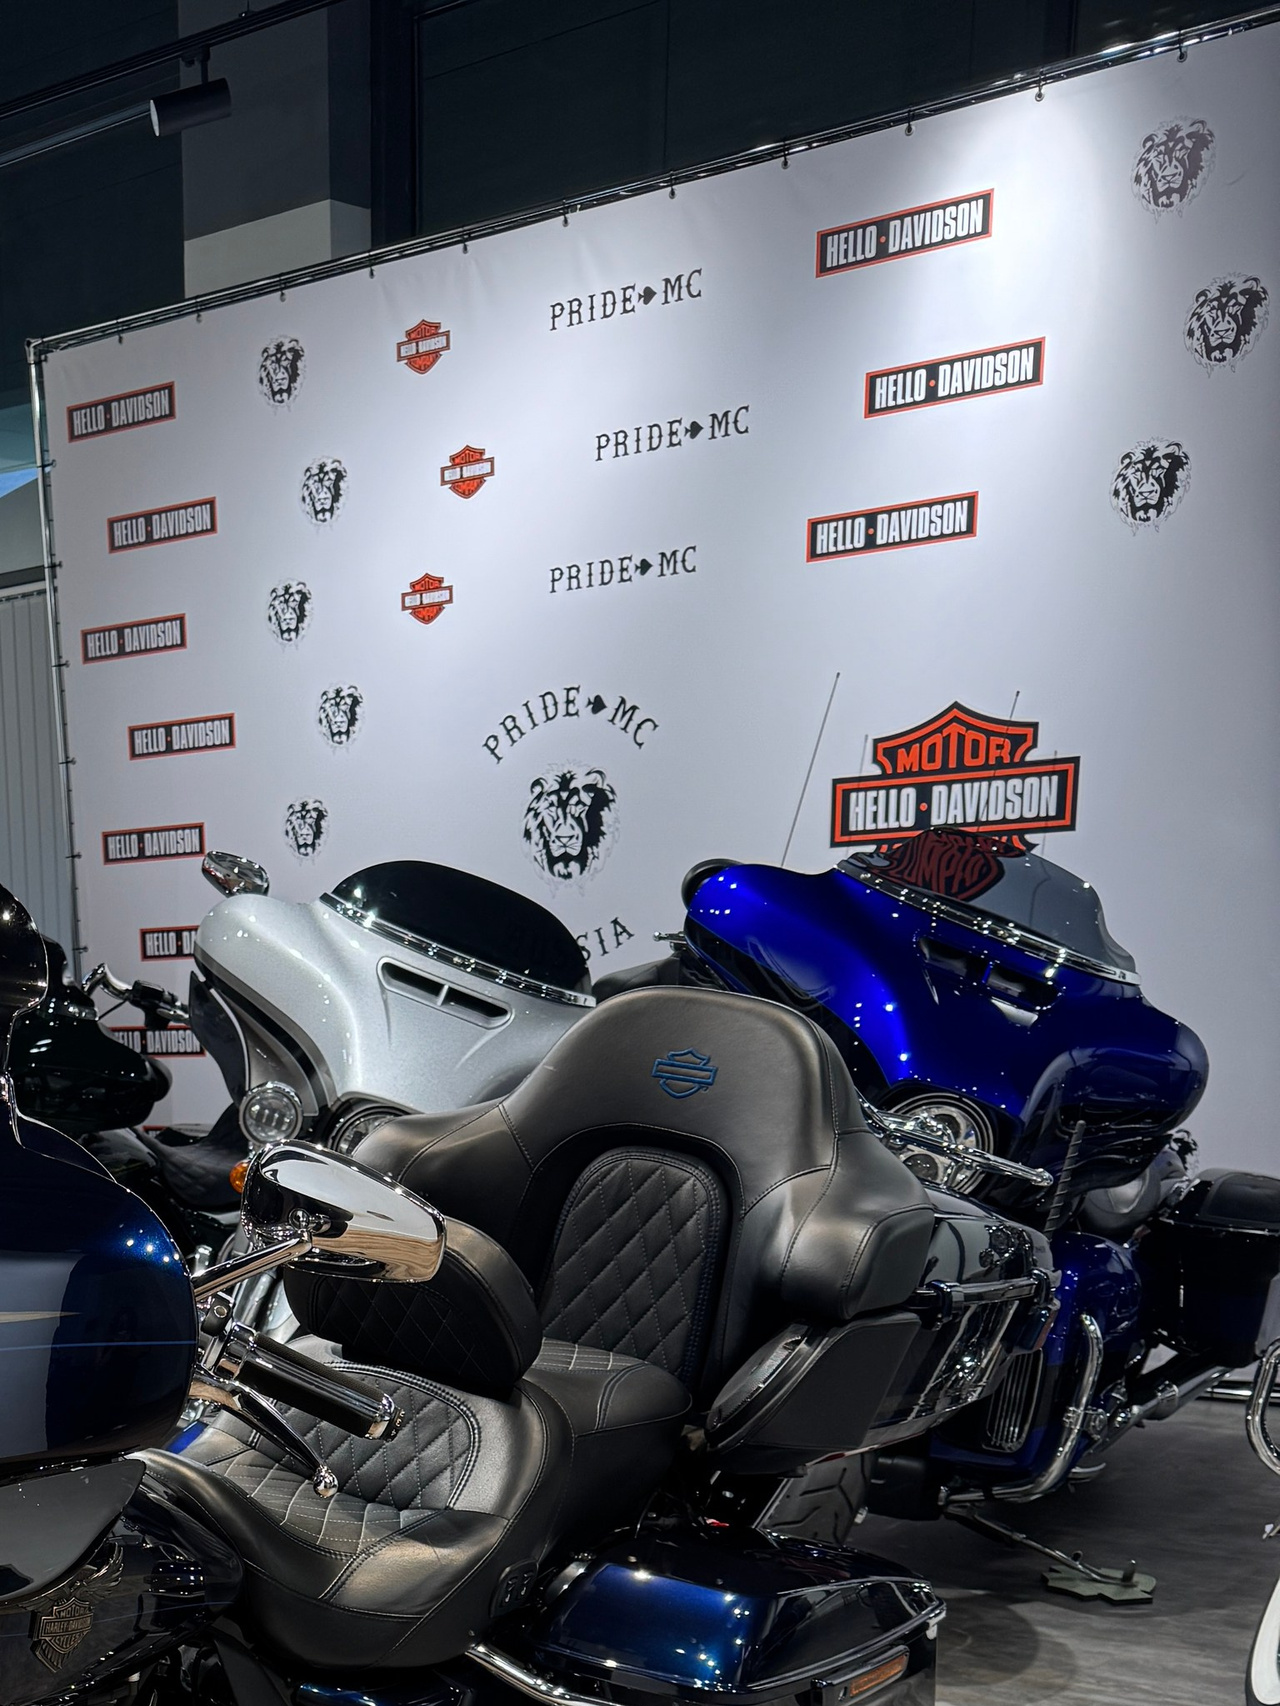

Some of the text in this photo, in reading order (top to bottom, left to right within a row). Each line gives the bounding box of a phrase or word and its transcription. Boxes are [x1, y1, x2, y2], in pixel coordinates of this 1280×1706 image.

[826, 199, 983, 269] HELLO DAVIDSON
[549, 284, 637, 331] PRIDE
[874, 346, 1035, 410] HELLO DAVIDSON
[72, 389, 170, 436] HELLO DAVIDSON
[595, 418, 684, 461] PRIDE
[113, 503, 211, 547] HELLO DAVIDSON
[816, 500, 968, 554] HELLO DAVIDSON
[549, 555, 634, 593] PRIDE
[86, 620, 181, 658] HELLO DAVIDSON
[134, 718, 231, 755] HELLO DAVIDSON
[482, 685, 581, 764] PRIDE
[897, 722, 1011, 773] MOTOR
[849, 775, 1059, 831] HELLO DAVIDSON
[107, 827, 200, 860] HELLO DAVIDSON
[145, 931, 177, 956] HELLO
[576, 917, 635, 962] SIA
